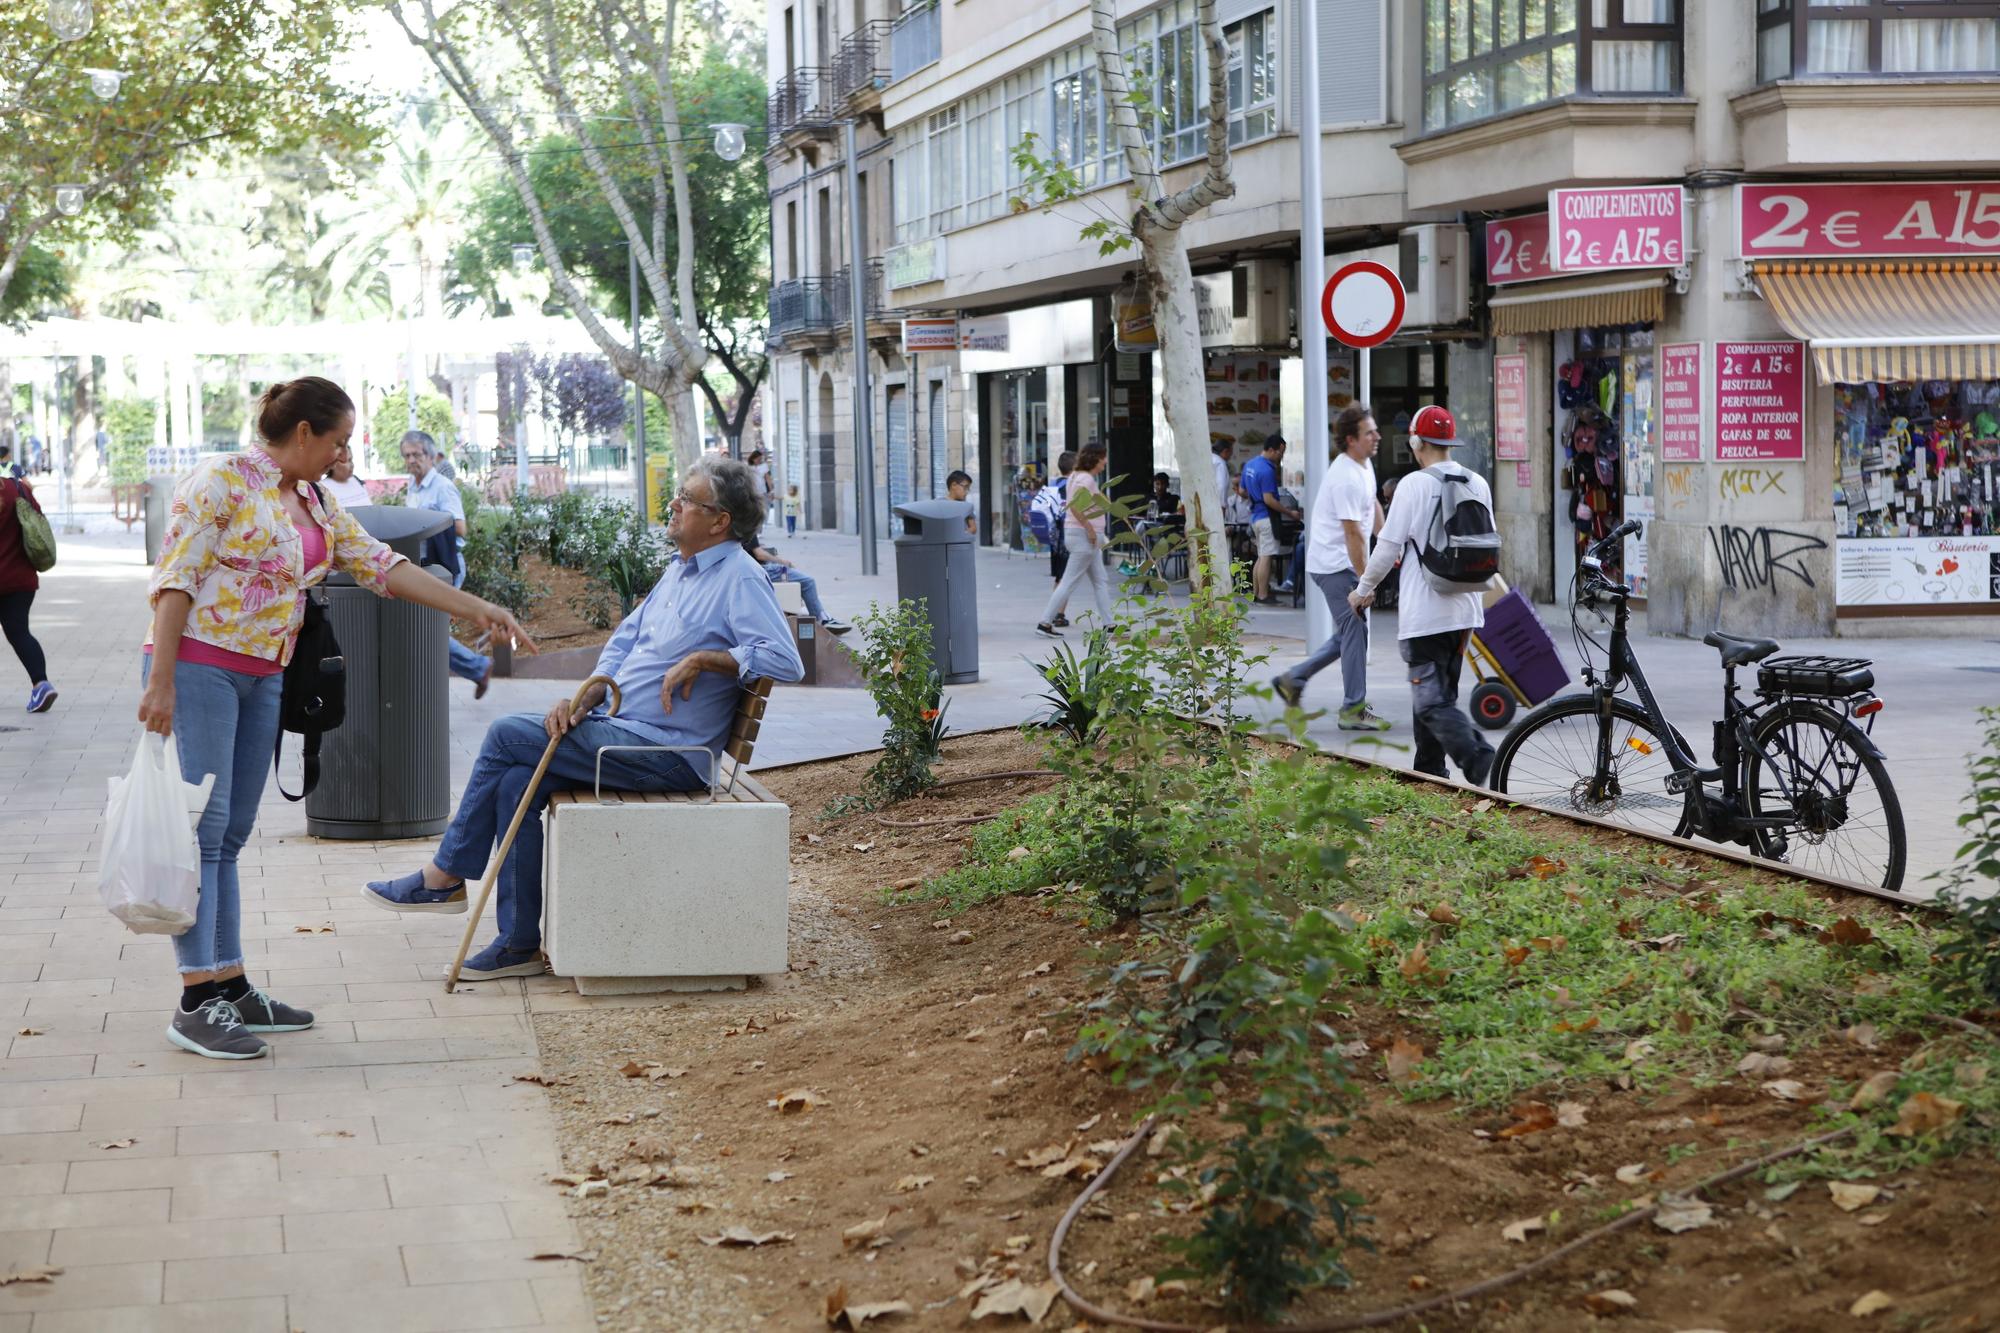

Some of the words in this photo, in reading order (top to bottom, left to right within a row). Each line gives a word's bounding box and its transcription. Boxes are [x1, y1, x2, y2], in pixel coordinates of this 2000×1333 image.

[1564, 191, 1675, 220] COMPLEMENTOS
[1725, 344, 1795, 355] COMPLEMENTOS
[1751, 358, 1762, 373] A
[1721, 379, 1773, 391] BISUTERIA
[1721, 395, 1784, 407] PERFUMERIA
[1721, 412, 1748, 424] ROPA
[1752, 412, 1799, 424] INTERIOR
[1721, 429, 1752, 441] GAFAS
[1757, 429, 1770, 441] DE
[1774, 428, 1792, 440] SOL
